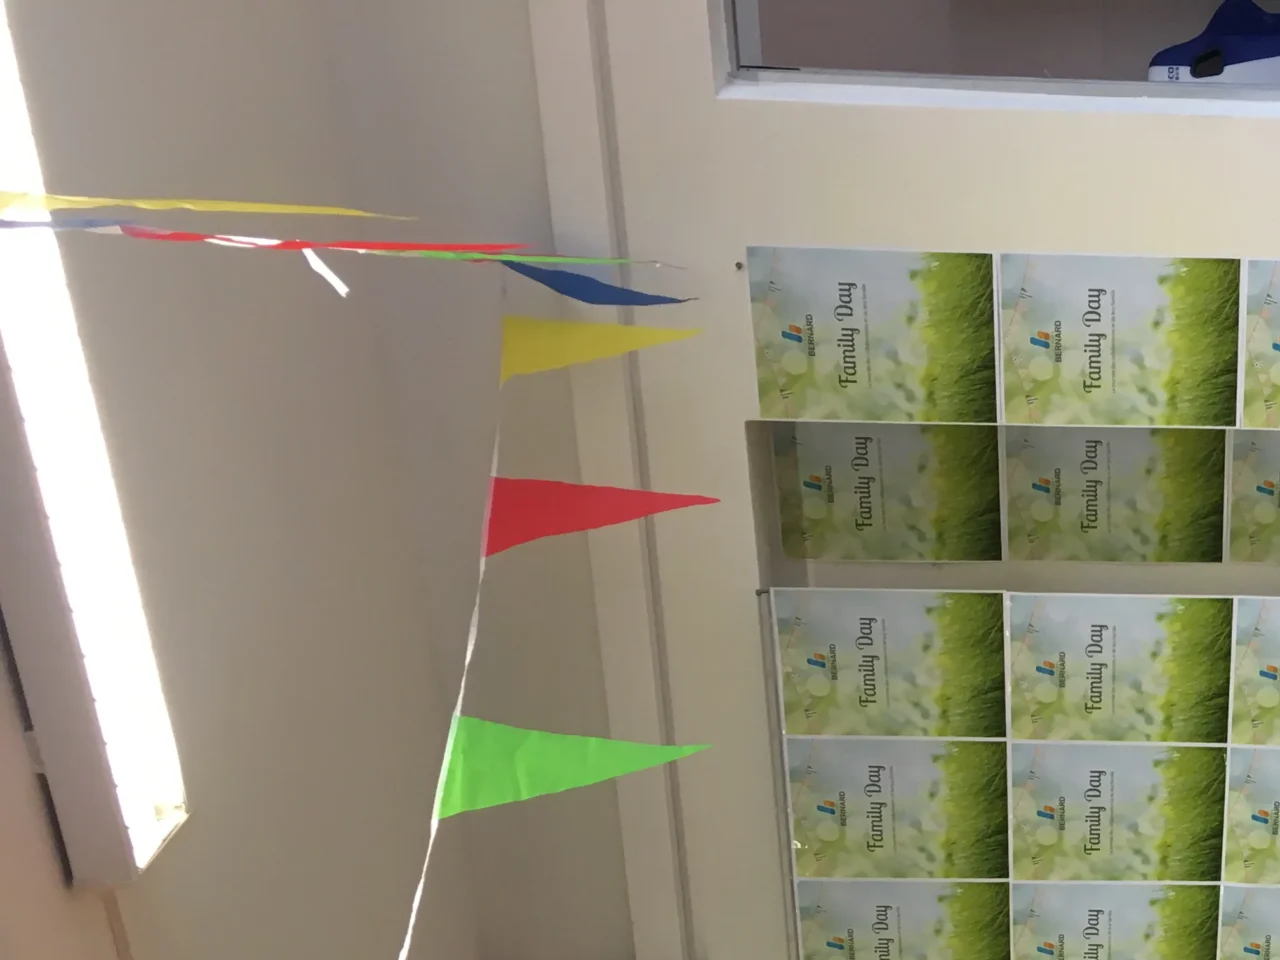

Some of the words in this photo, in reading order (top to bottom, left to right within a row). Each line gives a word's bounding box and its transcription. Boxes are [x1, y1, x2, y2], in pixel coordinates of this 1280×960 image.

[834, 282, 857, 321] Day
[1082, 289, 1107, 327] Day
[805, 314, 816, 357] BERNARD
[1054, 320, 1062, 363] BERNARD
[837, 328, 860, 388] Family
[1083, 333, 1107, 393] Family
[851, 437, 873, 471] Day
[1080, 440, 1103, 475] Day
[825, 465, 835, 503] BERNARD
[1053, 468, 1061, 506] BERNARD
[854, 476, 876, 531] Family
[1080, 480, 1103, 533] Family
[856, 618, 877, 650] Day
[1085, 625, 1108, 658] Day
[829, 644, 838, 680] BERNARD
[1057, 652, 1066, 688] BERNARD
[858, 655, 880, 707] Family
[1084, 663, 1108, 714] Family
[864, 766, 886, 797] Day
[1084, 771, 1106, 802] Day
[838, 791, 847, 826] BERNARD
[866, 802, 887, 852] Family
[1058, 797, 1066, 831] BERNARD
[1271, 801, 1280, 835] BERNARD
[1084, 806, 1106, 855] Family
[872, 906, 892, 934] Day
[1083, 910, 1104, 939] Day
[847, 928, 856, 960] BERNARD
